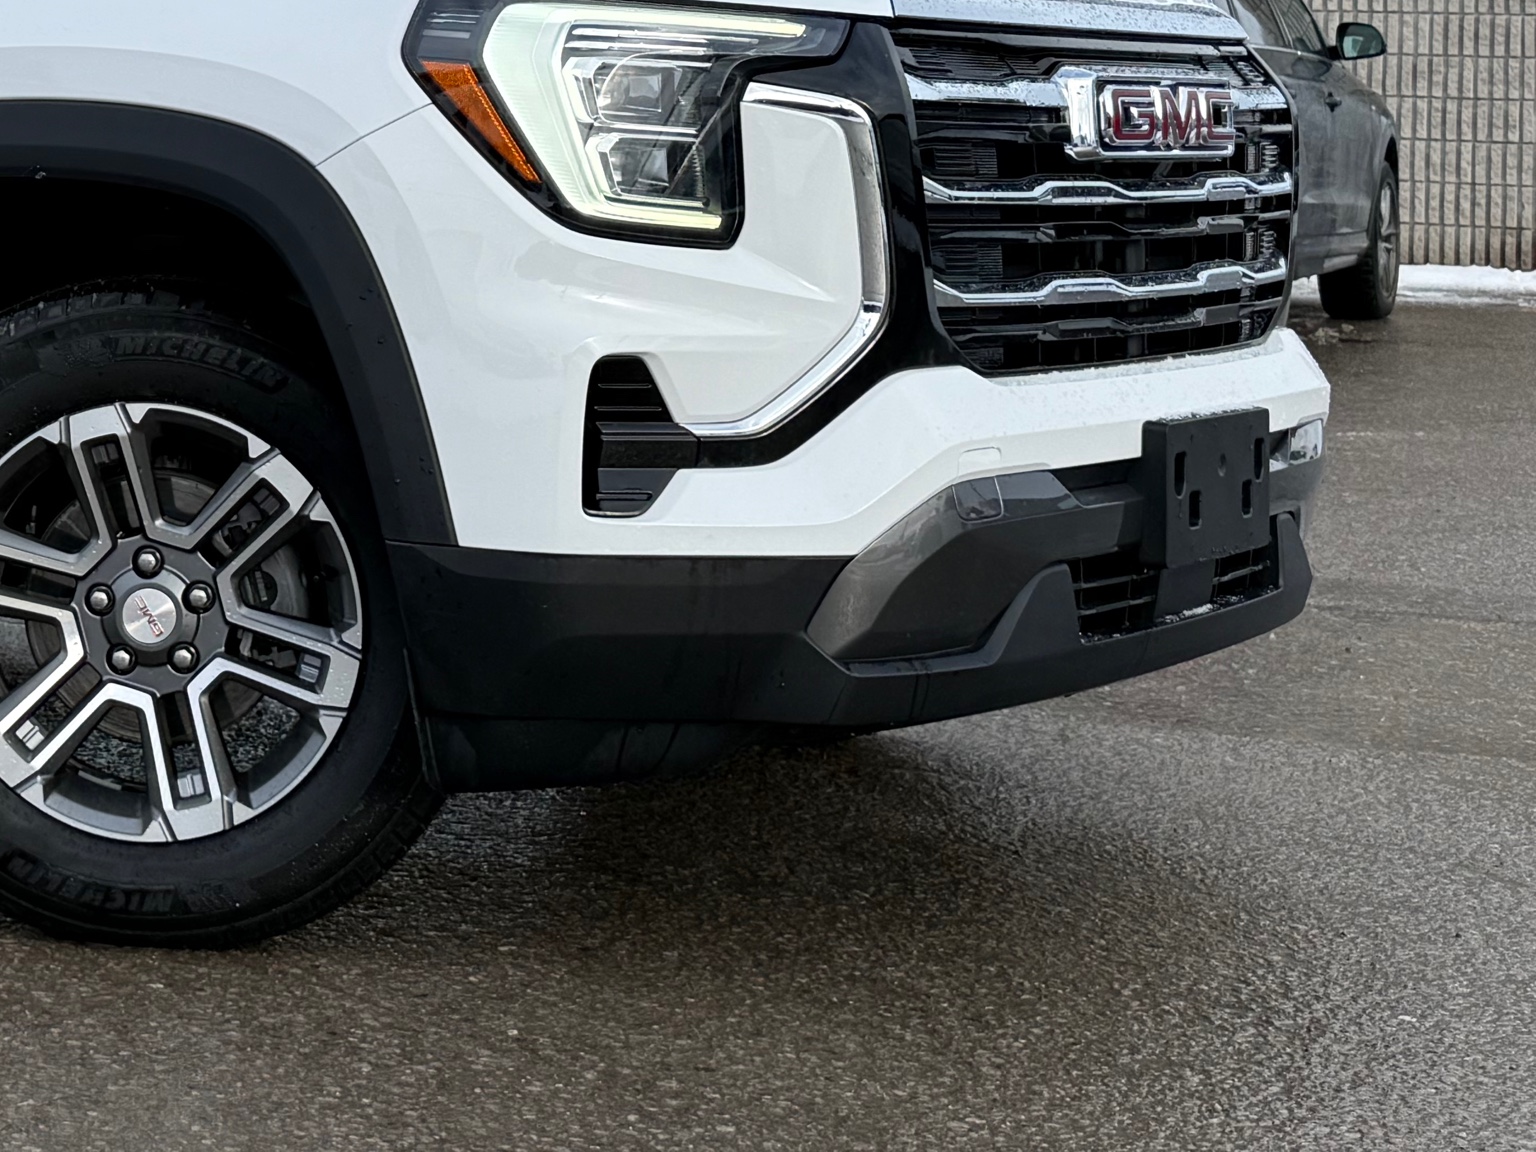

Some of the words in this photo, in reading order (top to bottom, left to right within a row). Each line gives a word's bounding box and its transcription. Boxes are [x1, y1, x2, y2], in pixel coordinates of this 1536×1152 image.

[1102, 84, 1236, 148] GMC
[115, 334, 285, 389] MICHELIN
[5, 853, 175, 913] MICHELIN
